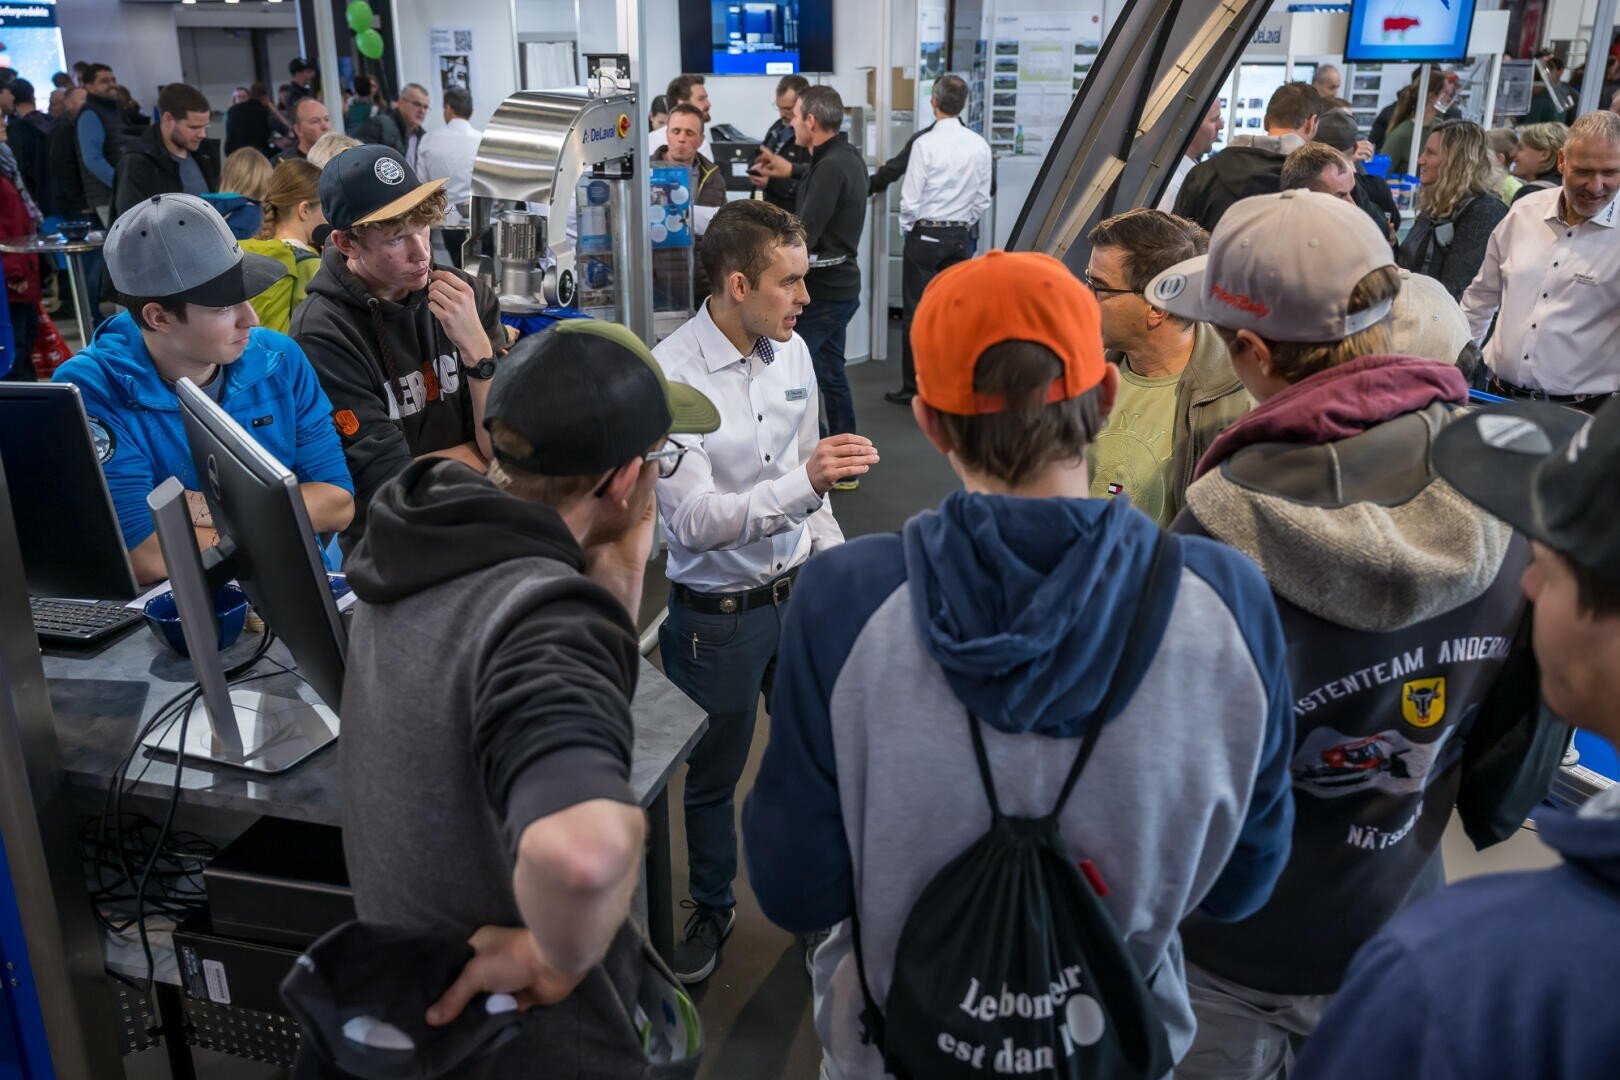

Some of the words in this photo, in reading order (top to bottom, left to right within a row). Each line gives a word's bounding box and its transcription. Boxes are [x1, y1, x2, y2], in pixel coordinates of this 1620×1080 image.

[591, 123, 616, 142] DeLaval
[1293, 647, 1424, 716] ISTENTEAM
[937, 1032, 986, 1069] est
[993, 1037, 1055, 1074] dan
